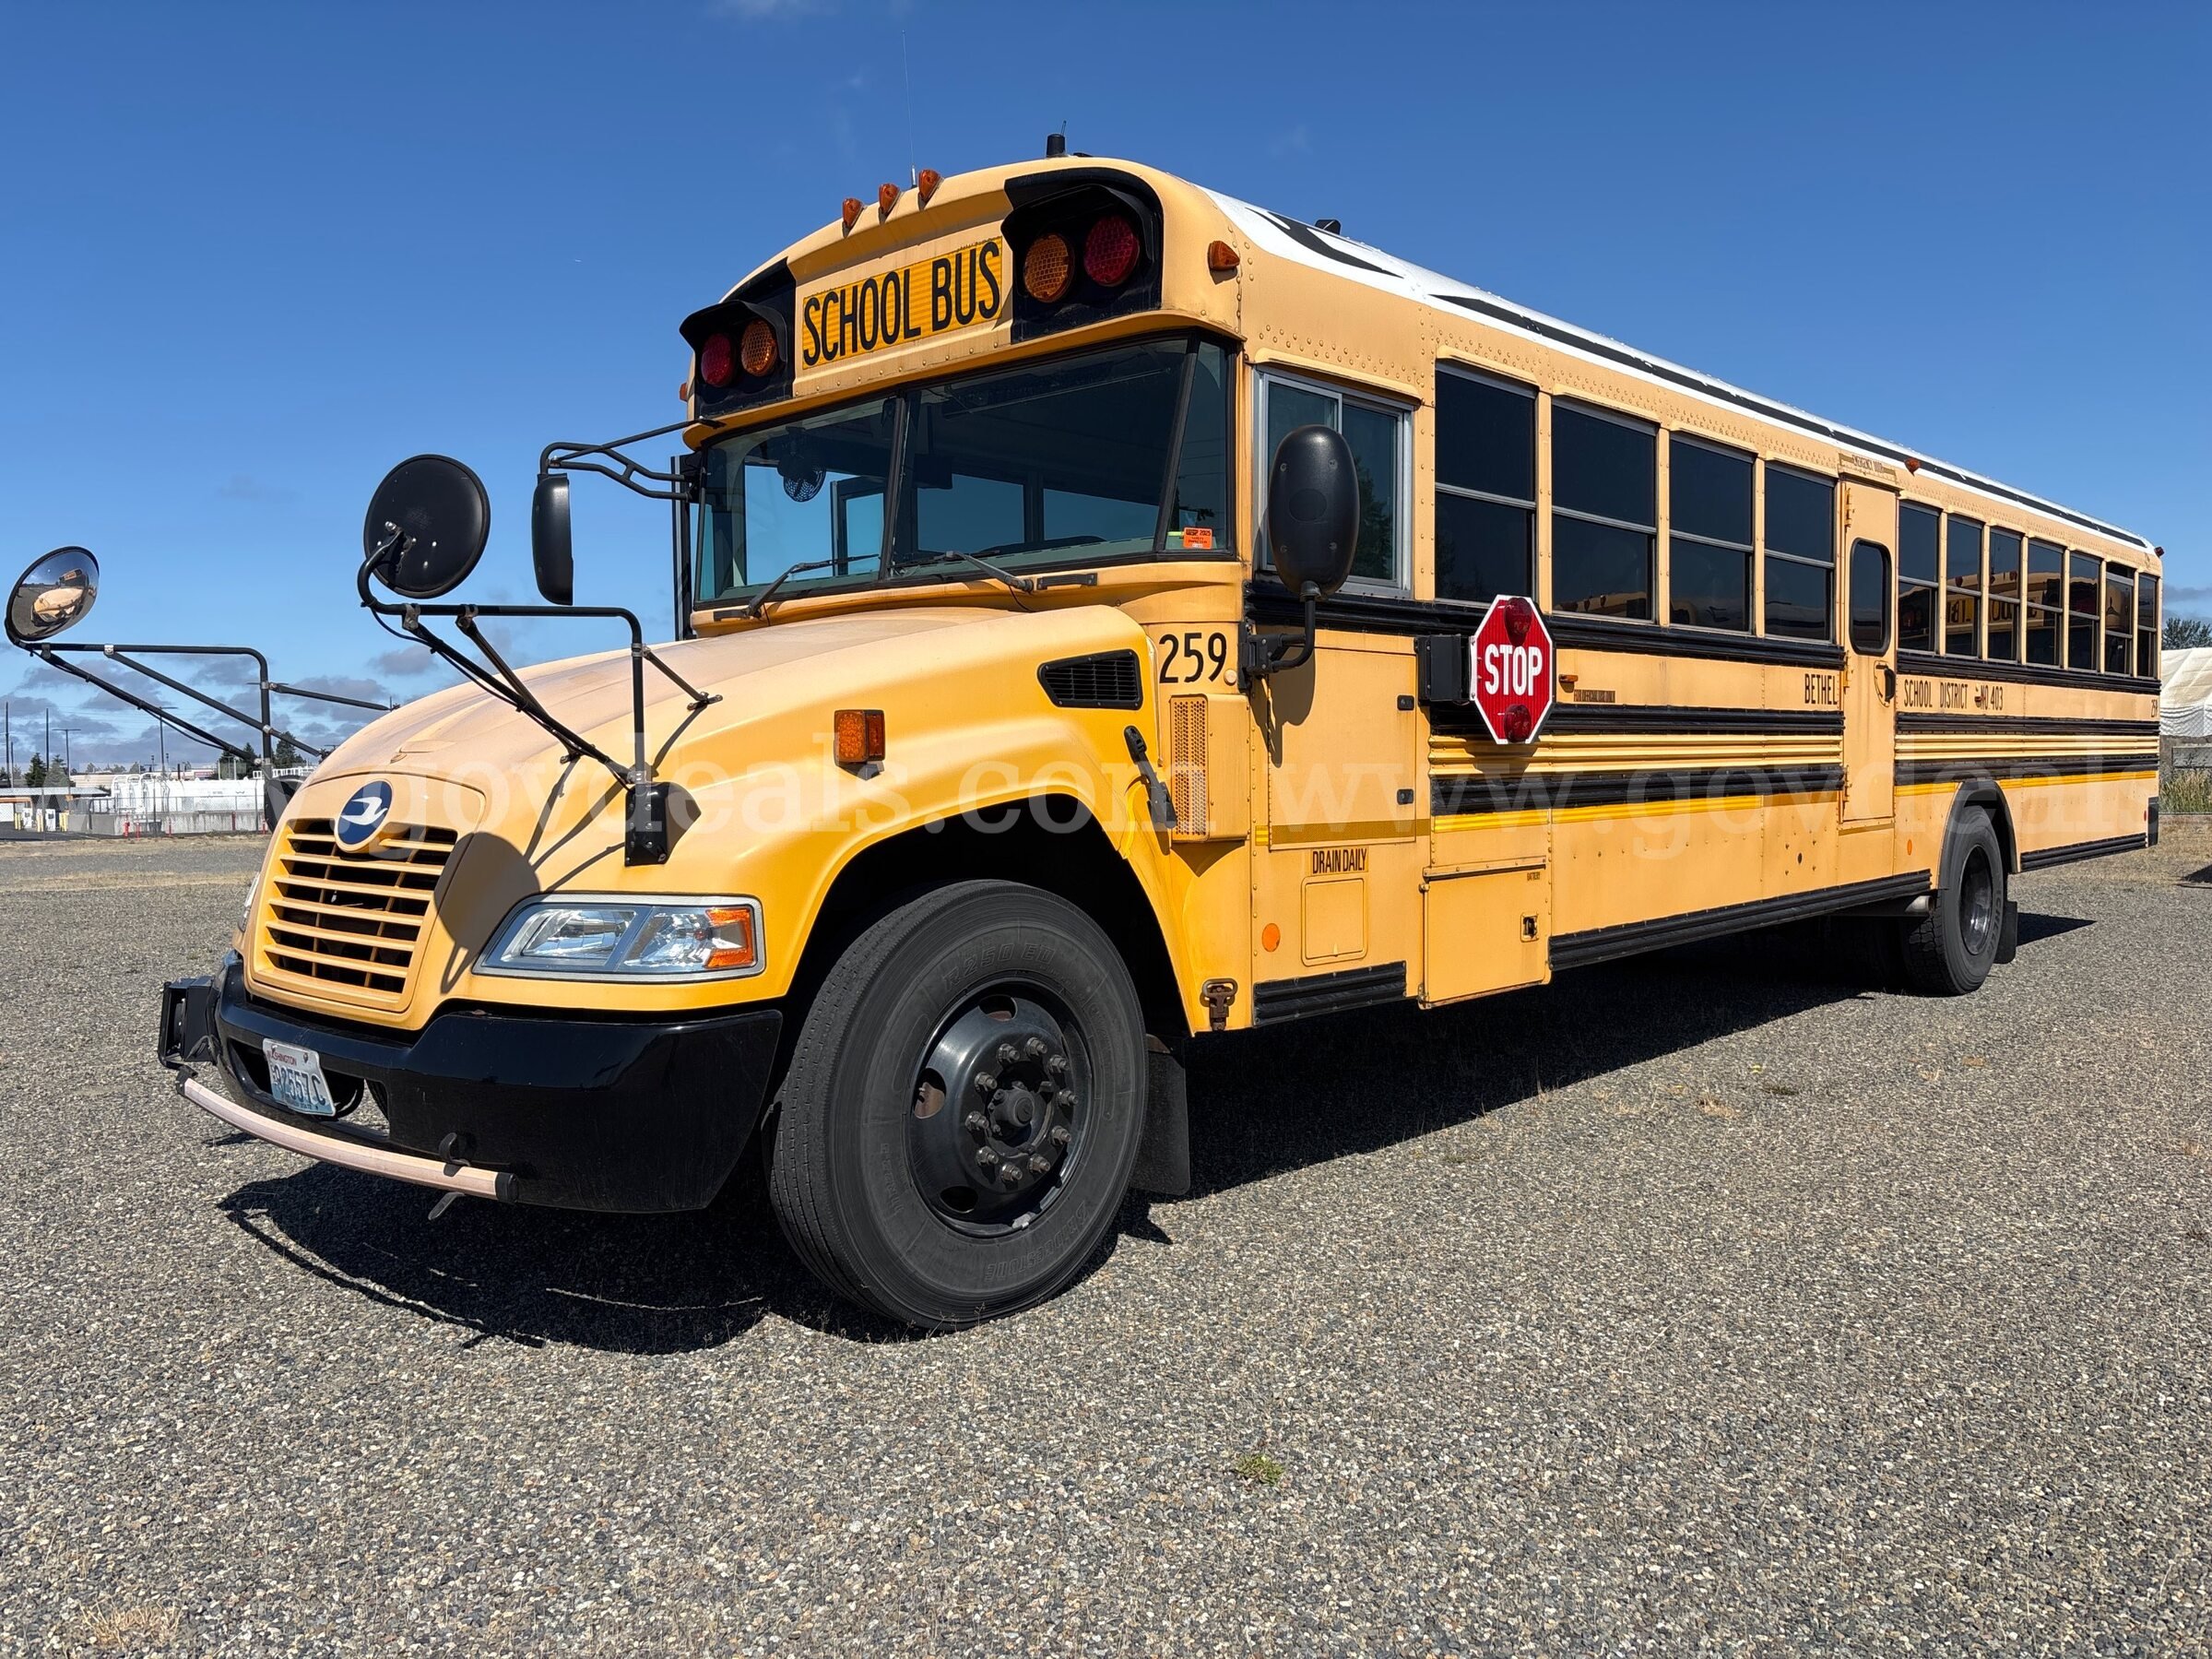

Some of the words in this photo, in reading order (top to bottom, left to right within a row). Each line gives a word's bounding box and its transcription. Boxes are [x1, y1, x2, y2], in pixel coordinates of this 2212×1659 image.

[803, 268, 921, 366] SCHOOL
[931, 241, 1000, 332] BUS
[1159, 632, 1227, 683] 259
[1485, 643, 1544, 696] STOP
[1804, 673, 1838, 705] BETHEL
[1903, 679, 1933, 708] SCHOOL
[1939, 681, 1969, 710] DISTRICT
[1312, 849, 1342, 874] DRAIN
[1343, 847, 1367, 871] DAILY
